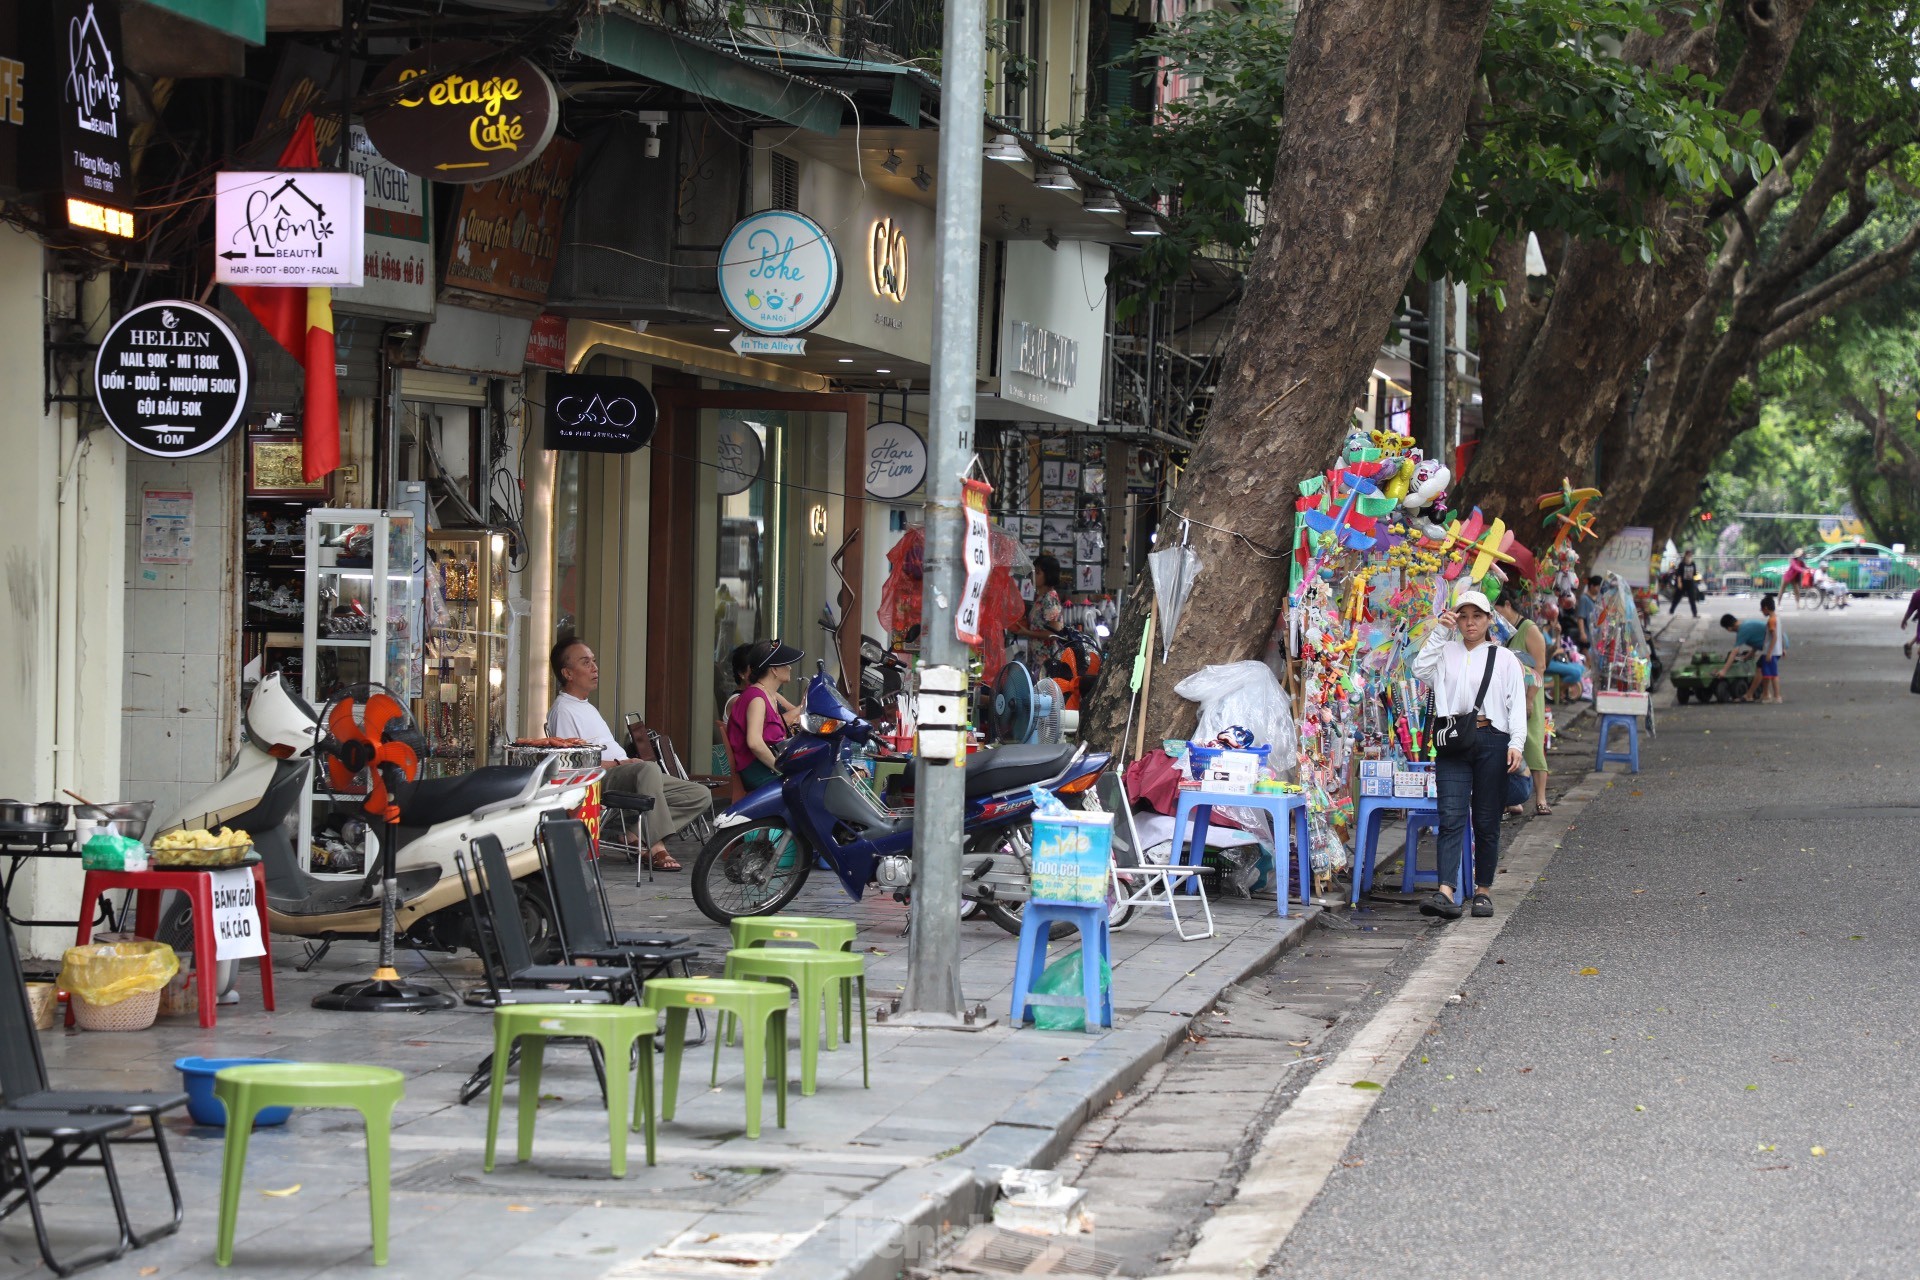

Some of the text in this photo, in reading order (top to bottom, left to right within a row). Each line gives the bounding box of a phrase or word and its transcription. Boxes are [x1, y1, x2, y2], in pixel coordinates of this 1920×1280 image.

[90, 117, 114, 135] BEAUTY
[469, 114, 525, 152] Café
[73, 150, 79, 166] 7
[79, 151, 97, 175] Hang
[97, 156, 113, 179] Khay
[276, 249, 317, 258] BEAUTY
[748, 228, 805, 282] Poke
[230, 266, 249, 274] HAIR
[255, 266, 277, 274] FOOT
[283, 266, 305, 275] BODY
[312, 266, 339, 275] FACIAL
[130, 329, 211, 348] HELLEN
[741, 340, 794, 352] In The Alley
[120, 352, 145, 367] NAIL
[147, 353, 168, 368] 90K
[177, 354, 191, 369] MI
[193, 355, 220, 370] 180K
[102, 370, 125, 390] UỐN
[169, 375, 209, 395] NHUỘM
[210, 378, 236, 394] 500K
[137, 397, 156, 417] GỘI
[181, 401, 202, 417] 50K
[156, 434, 185, 444] 10M
[958, 430, 968, 449] H
[214, 884, 238, 909] BÁNH
[219, 915, 232, 940] HÁ
